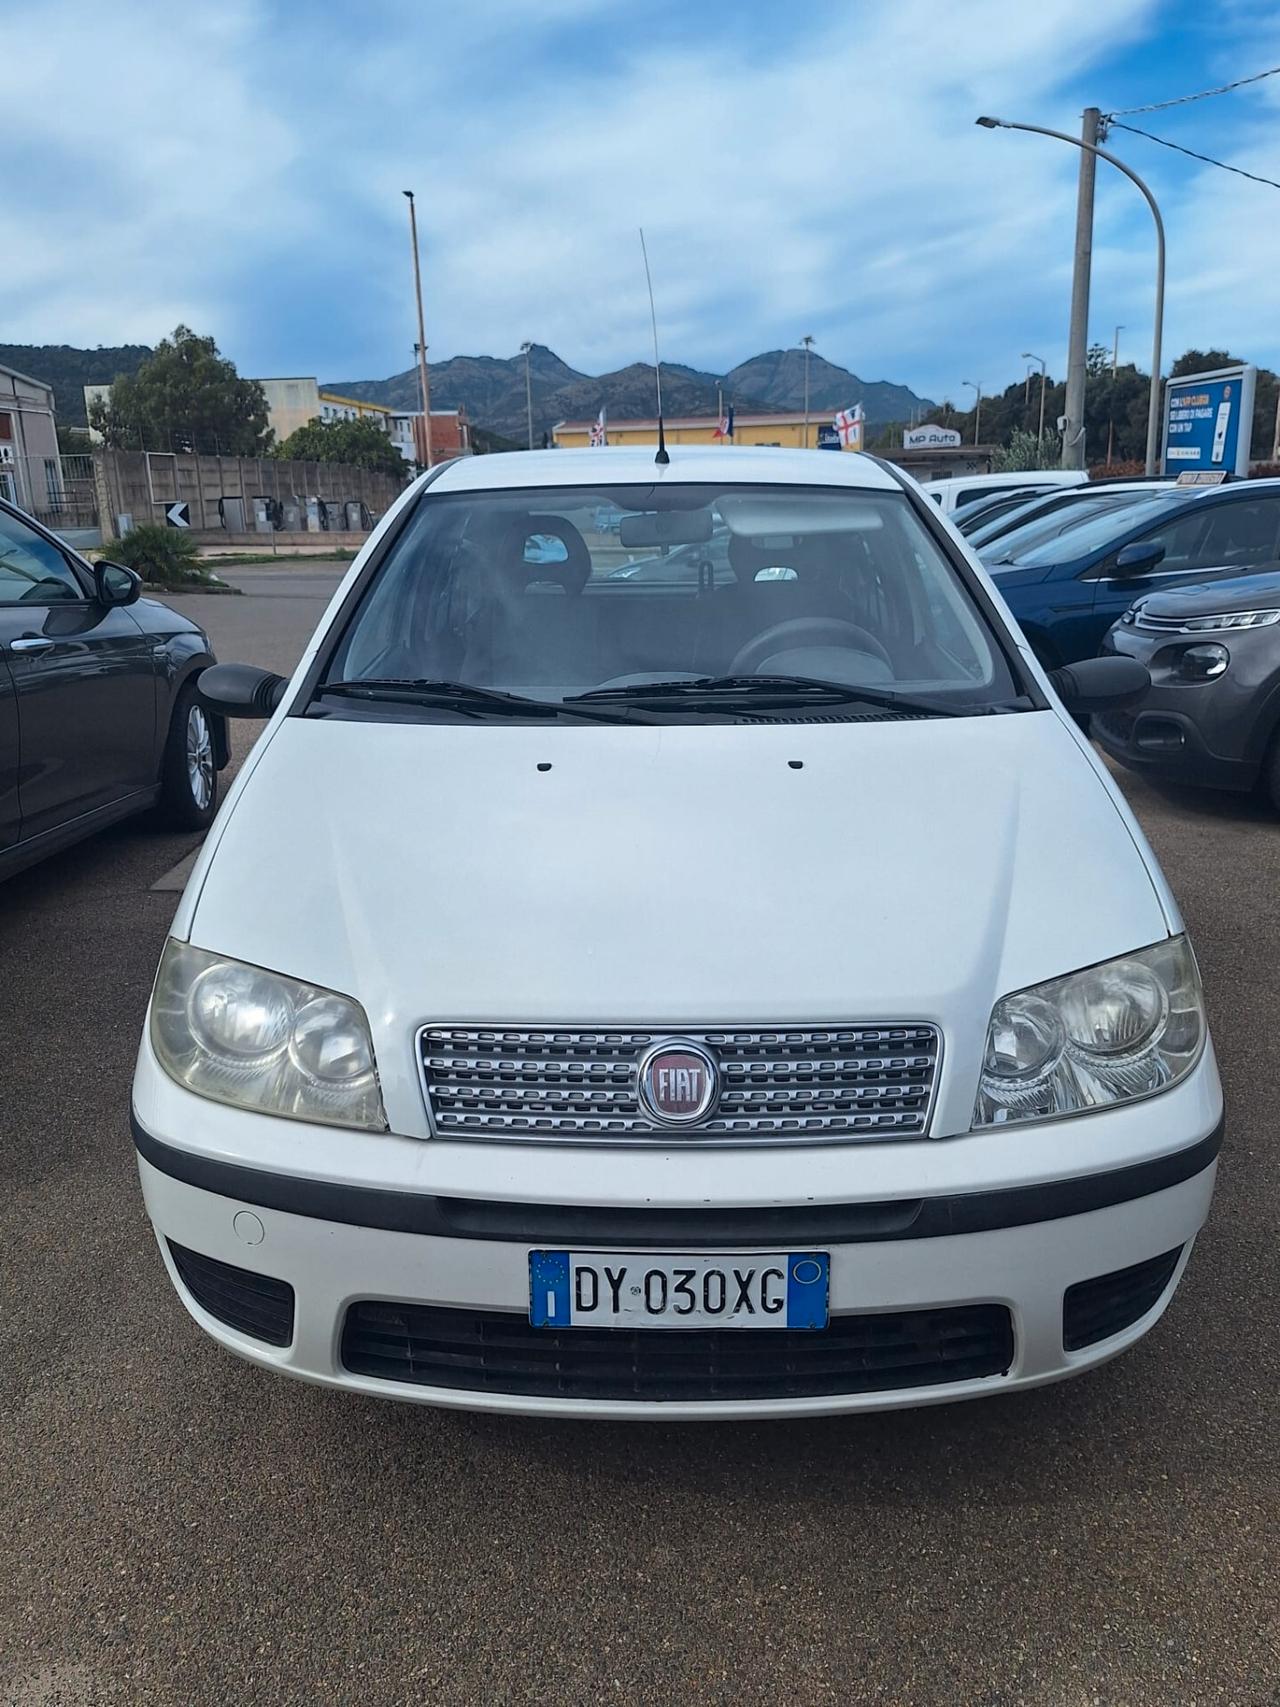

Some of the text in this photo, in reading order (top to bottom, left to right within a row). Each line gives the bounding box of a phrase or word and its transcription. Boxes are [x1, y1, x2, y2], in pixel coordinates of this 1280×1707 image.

[909, 434, 956, 444] MP Auto
[658, 1068, 701, 1102] FIAT
[575, 1266, 785, 1315] DY 030XG
